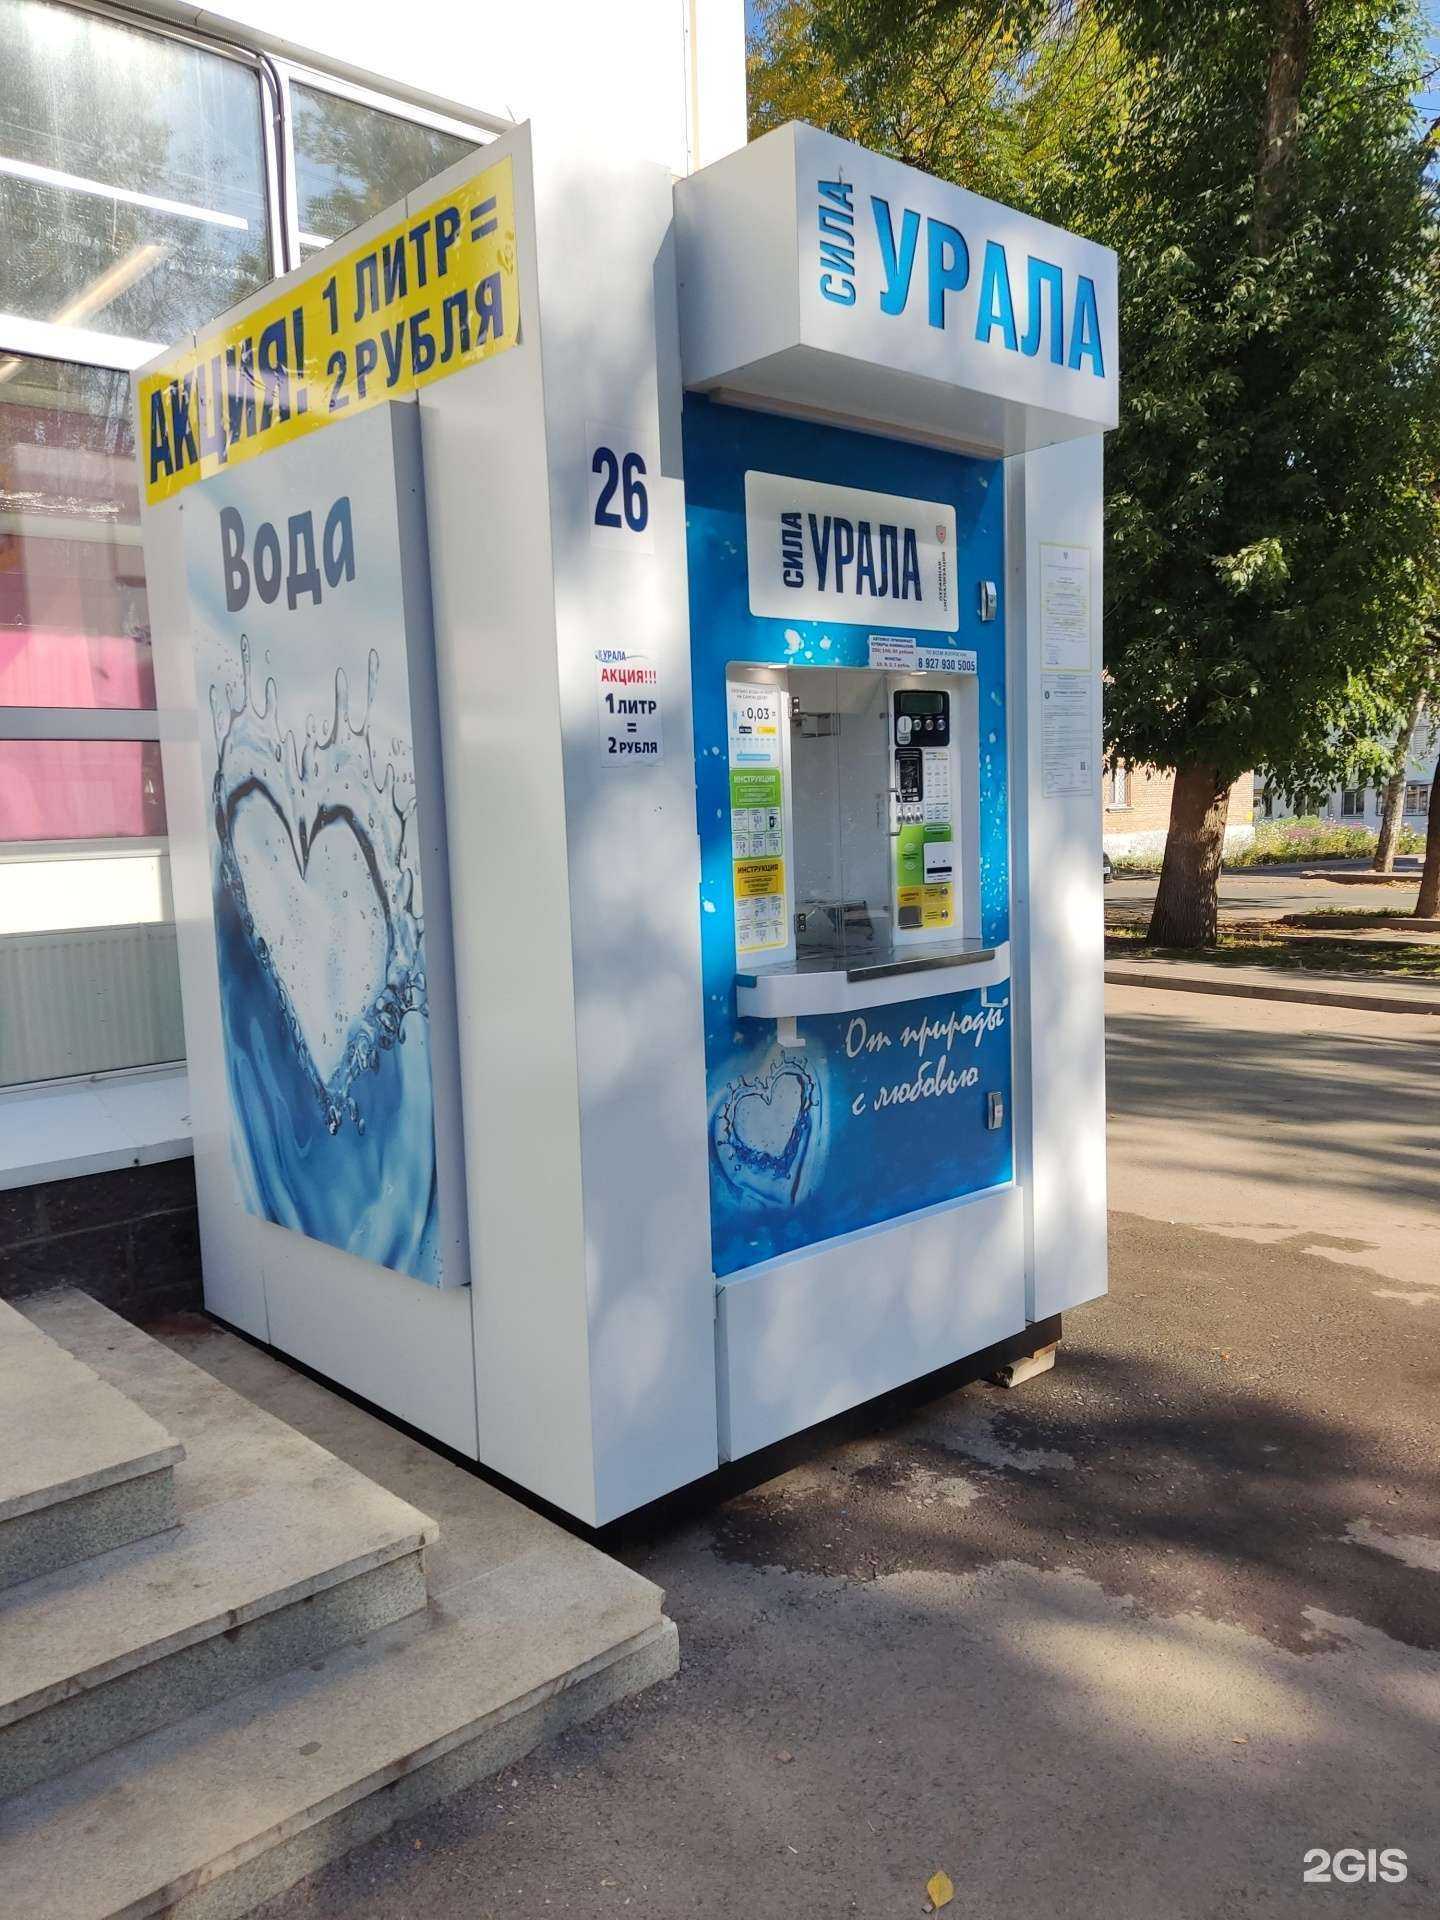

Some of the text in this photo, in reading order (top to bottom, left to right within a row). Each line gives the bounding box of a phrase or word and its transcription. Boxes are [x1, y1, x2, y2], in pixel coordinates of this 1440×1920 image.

[323, 276, 338, 335] 1
[354, 207, 461, 323] ЛИТР
[817, 180, 1105, 378] СИЛА УРАЛА
[327, 272, 504, 413] 2 РУБЛЯ
[150, 306, 308, 484] АКЦИЯ!
[592, 446, 648, 532] 26
[220, 496, 355, 612] Вода
[781, 512, 922, 601] СИЛА УРАЛА
[601, 668, 657, 685] АКЦИЯ!!!
[602, 649, 626, 660] УРАЛА
[918, 658, 923, 669] 8
[926, 658, 939, 669] 927
[942, 659, 955, 670] 930
[958, 660, 975, 672] 5005
[605, 693, 657, 714] 1 ЛИТР
[747, 707, 770, 722] 0,03
[608, 736, 658, 754] 2 РУБЛЯ
[737, 864, 779, 874] ИНСТРУКЦИЯ
[846, 1008, 1004, 1057] От природы
[852, 1055, 978, 1115] с любовью
